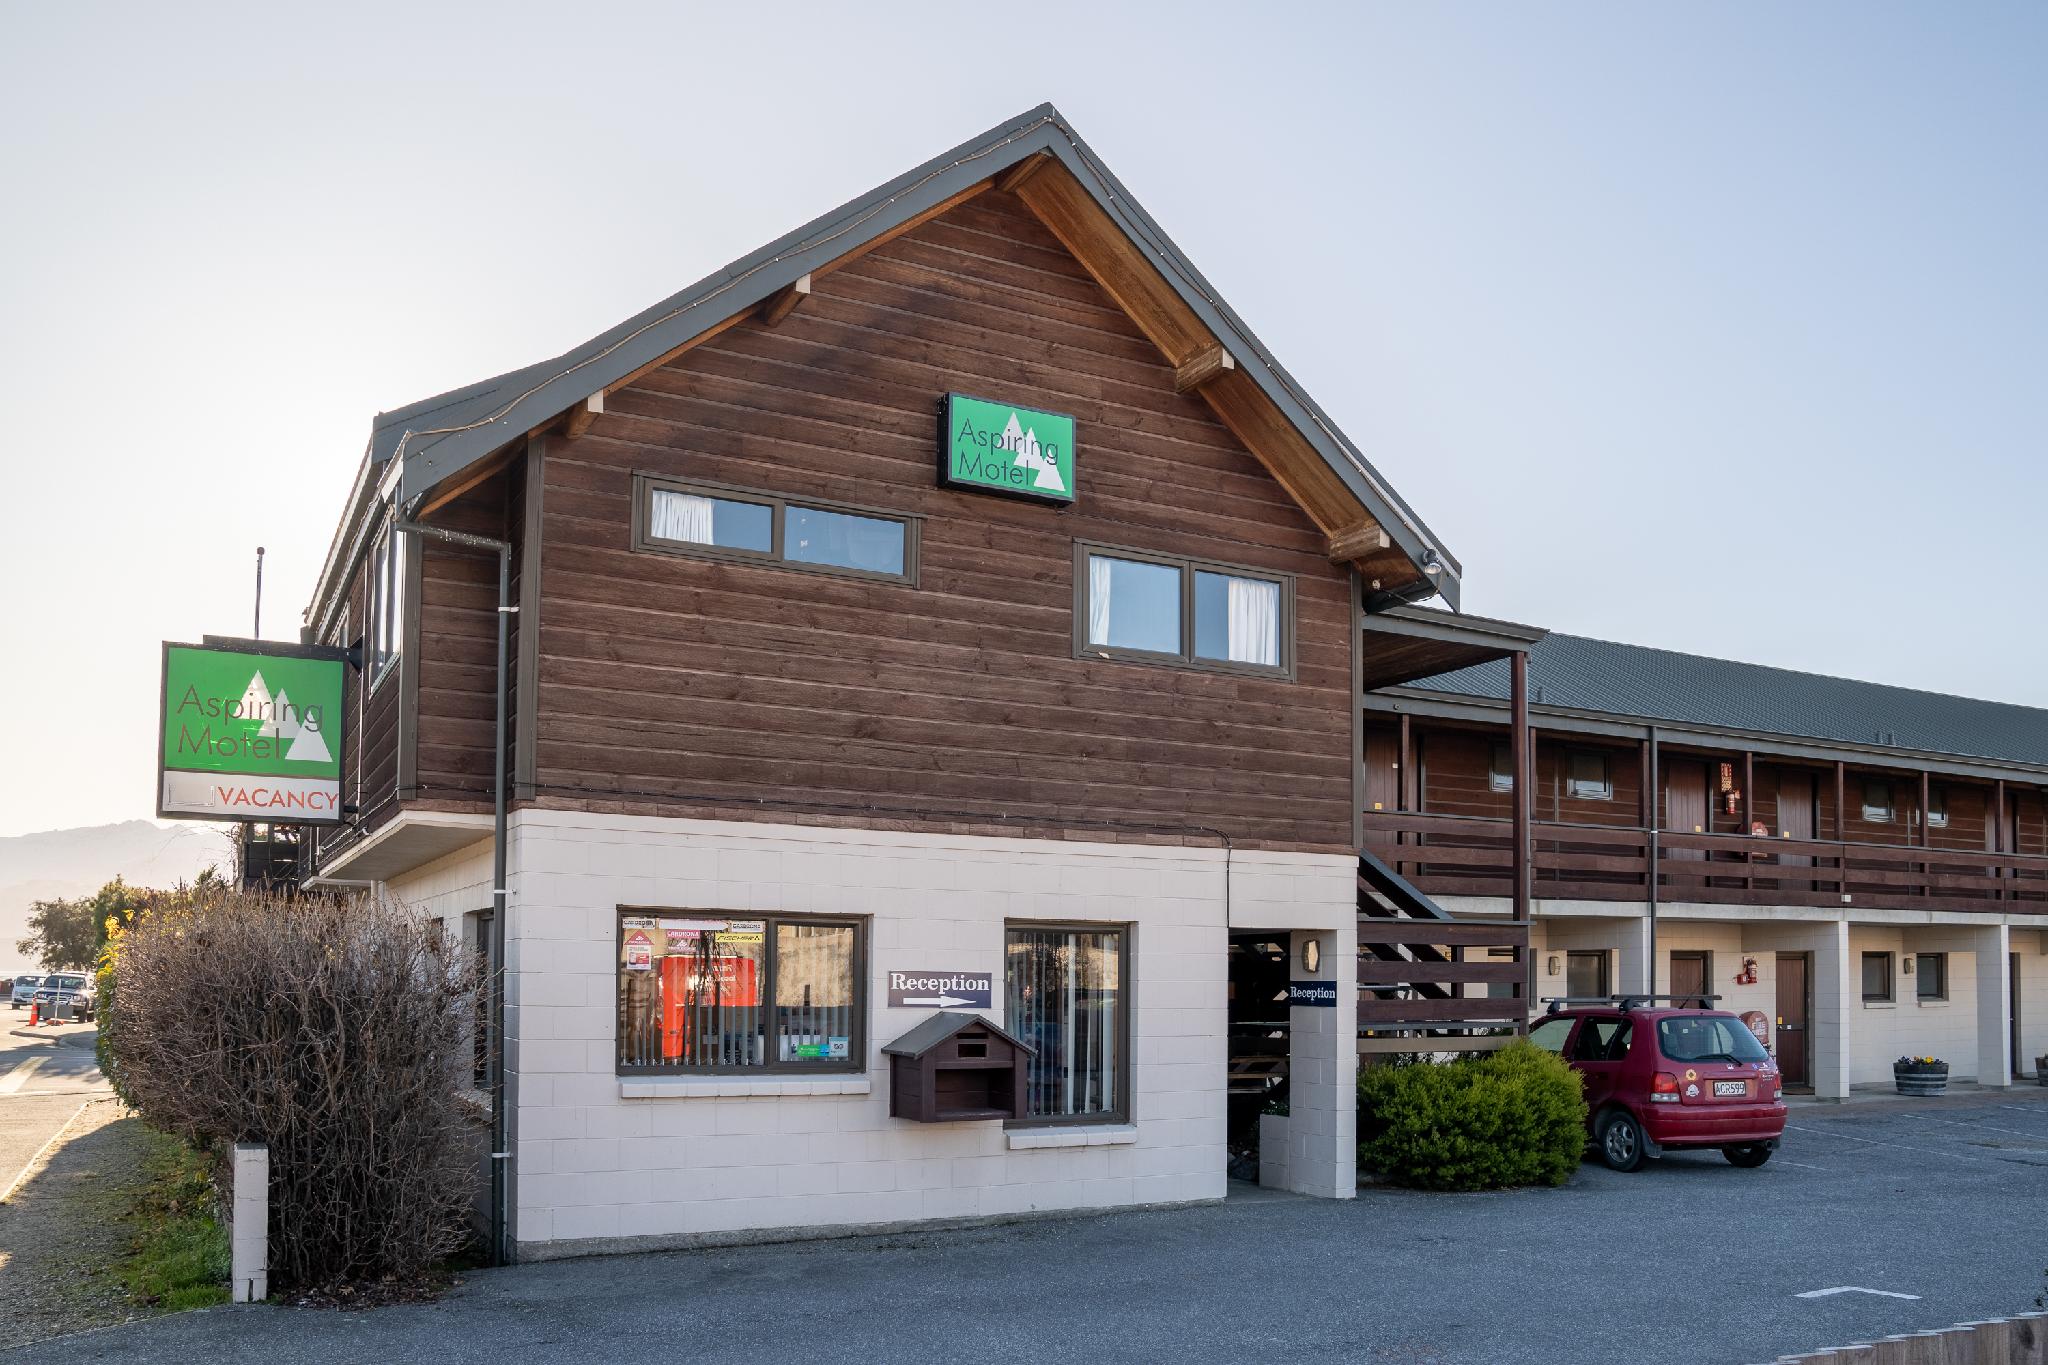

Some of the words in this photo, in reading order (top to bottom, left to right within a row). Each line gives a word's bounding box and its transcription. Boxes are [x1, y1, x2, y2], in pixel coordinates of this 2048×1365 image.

[957, 417, 1059, 466] Aspiring
[958, 449, 1029, 486] Motel
[176, 684, 324, 733] Aspiring
[177, 723, 281, 760] Motel
[217, 786, 339, 810] VACANCY
[890, 973, 990, 995] Reception
[1290, 986, 1336, 1001] Reception
[1715, 1083, 1745, 1095] ACR599
